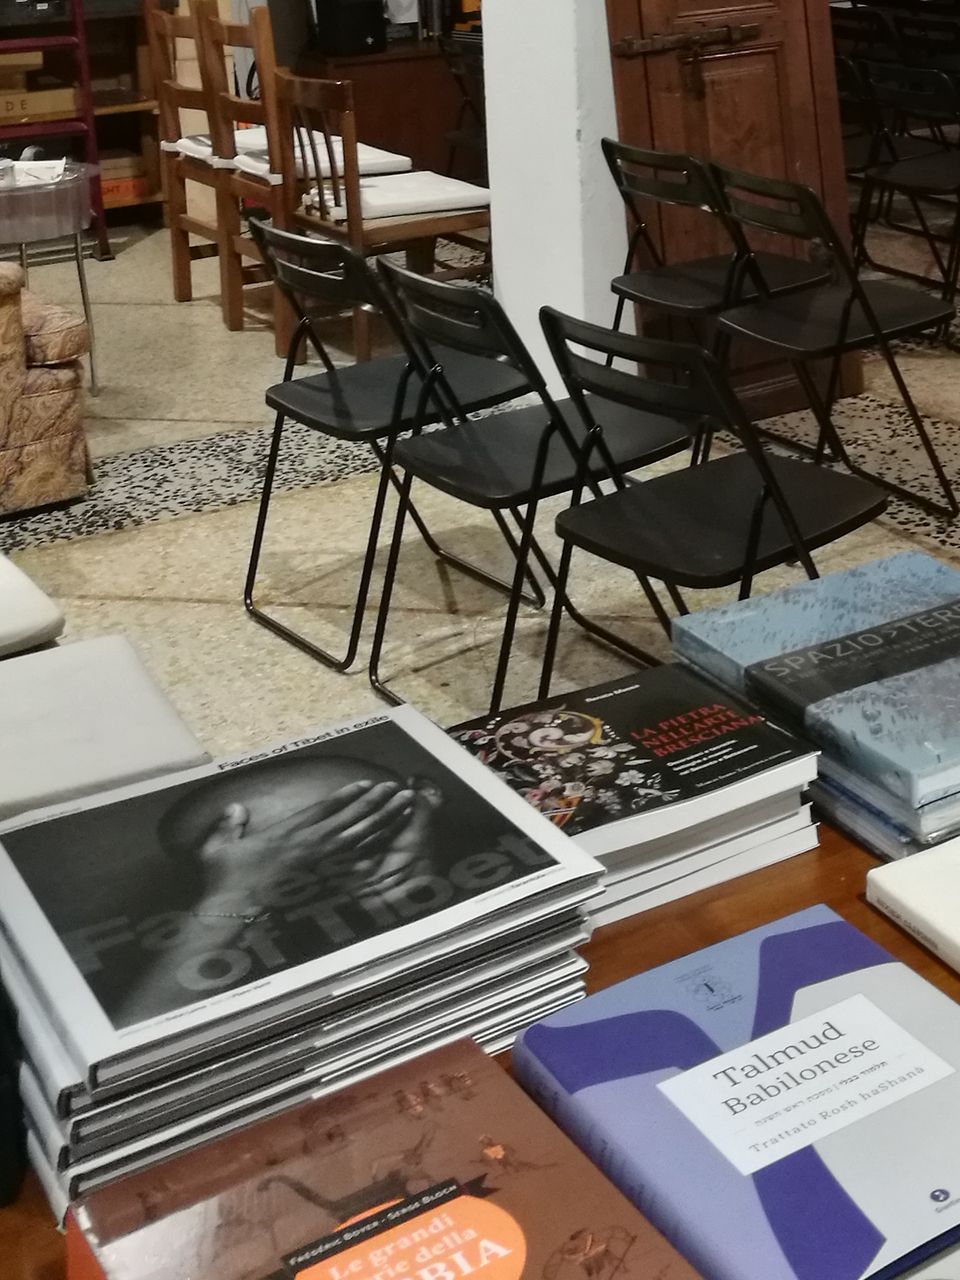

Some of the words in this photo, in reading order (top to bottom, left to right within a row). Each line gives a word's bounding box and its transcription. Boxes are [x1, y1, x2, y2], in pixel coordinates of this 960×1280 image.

[218, 753, 268, 771] Faces
[272, 744, 287, 755] of
[288, 732, 333, 748] Tibet
[335, 725, 351, 736] in
[353, 714, 390, 729] exile
[631, 727, 656, 740] LA
[658, 703, 727, 728] PIETRA
[652, 714, 762, 758] BRESCIANA
[177, 926, 288, 992] of
[285, 834, 554, 945] Tibet
[712, 1021, 847, 1088] Talmud
[721, 1039, 881, 1116] Babilonese
[748, 1115, 818, 1154] Trattato
[819, 1097, 859, 1121] Rosh
[328, 1258, 364, 1280] Le
[368, 1212, 455, 1267] grandi
[412, 1238, 513, 1280] BIA
[415, 1226, 478, 1264] della
